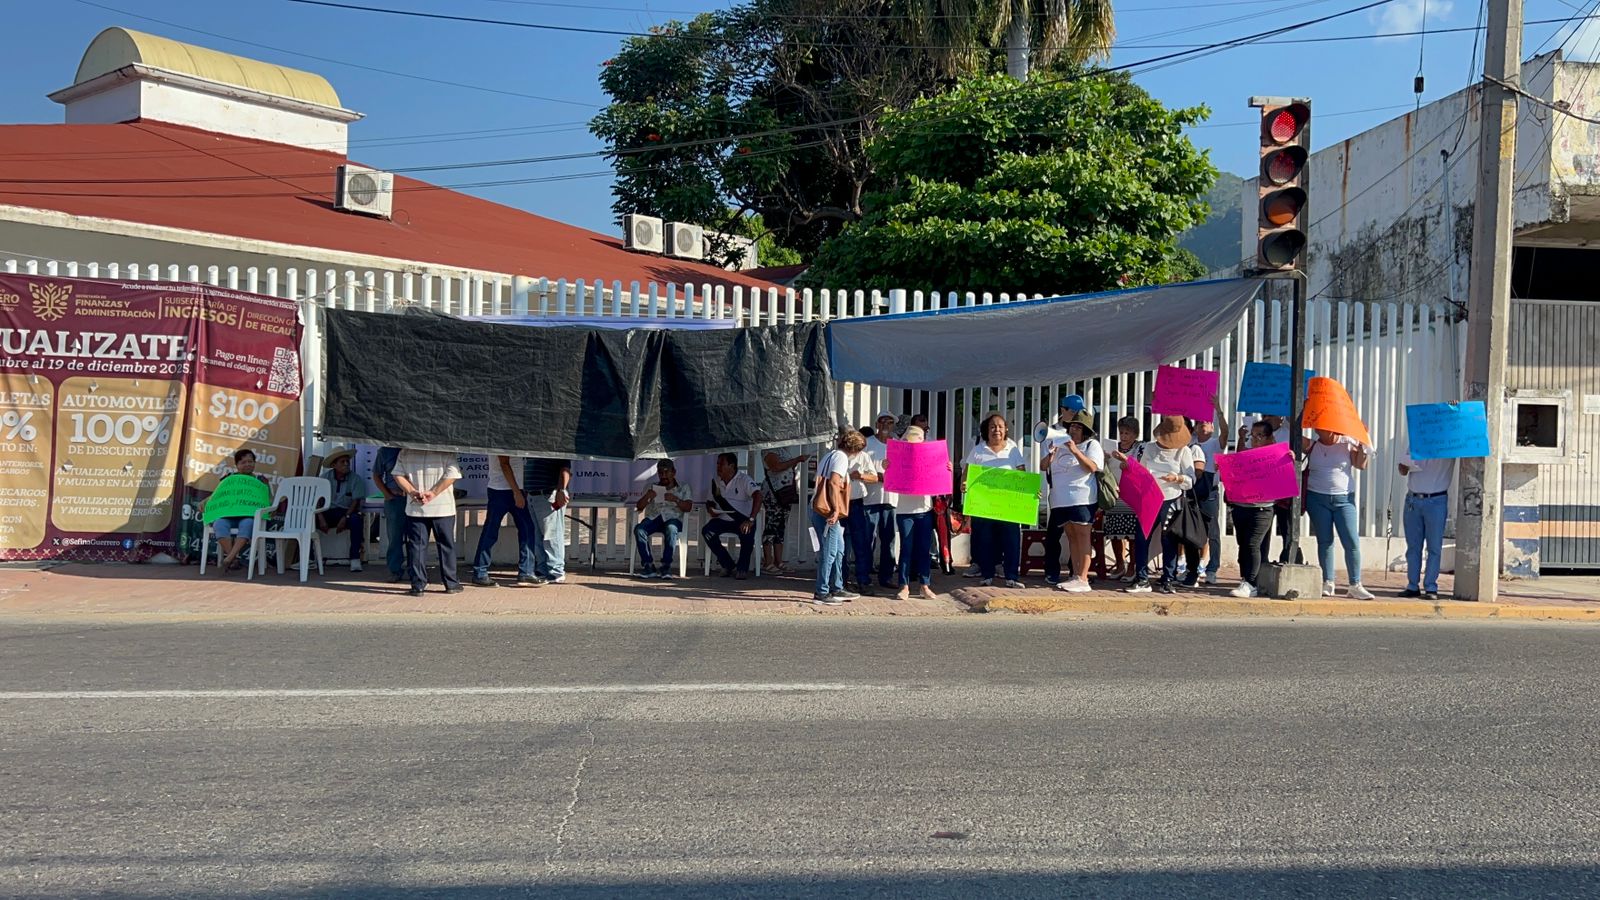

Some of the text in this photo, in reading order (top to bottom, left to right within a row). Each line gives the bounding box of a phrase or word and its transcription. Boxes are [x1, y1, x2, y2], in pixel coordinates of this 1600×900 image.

[75, 299, 122, 308] FINANZAS
[165, 296, 238, 312] SUBSECREARÍA DE
[74, 308, 156, 318] ADMINISTRACIÓN
[165, 306, 237, 326] INGRESOS
[247, 312, 285, 325] DIRECCIÓN
[245, 320, 258, 330] DE
[0, 328, 194, 362] UALIZATE.
[215, 348, 235, 361] Pago
[248, 354, 270, 366] línea:
[32, 358, 44, 369] al
[48, 359, 64, 370] 19
[68, 360, 84, 371] de
[88, 360, 156, 374] diciembre
[234, 362, 255, 373] código
[63, 394, 178, 410] AUTOMOVILES
[209, 390, 280, 425] $100
[70, 412, 170, 445] 100%
[218, 421, 269, 441] PESOS
[19, 444, 38, 453] EN:
[68, 445, 84, 454] DE
[86, 446, 155, 456] DESCUENTO
[195, 438, 276, 465] En cabio
[57, 478, 65, 486] Y
[66, 478, 106, 486] MULTAS
[68, 506, 108, 515] MULTAS
